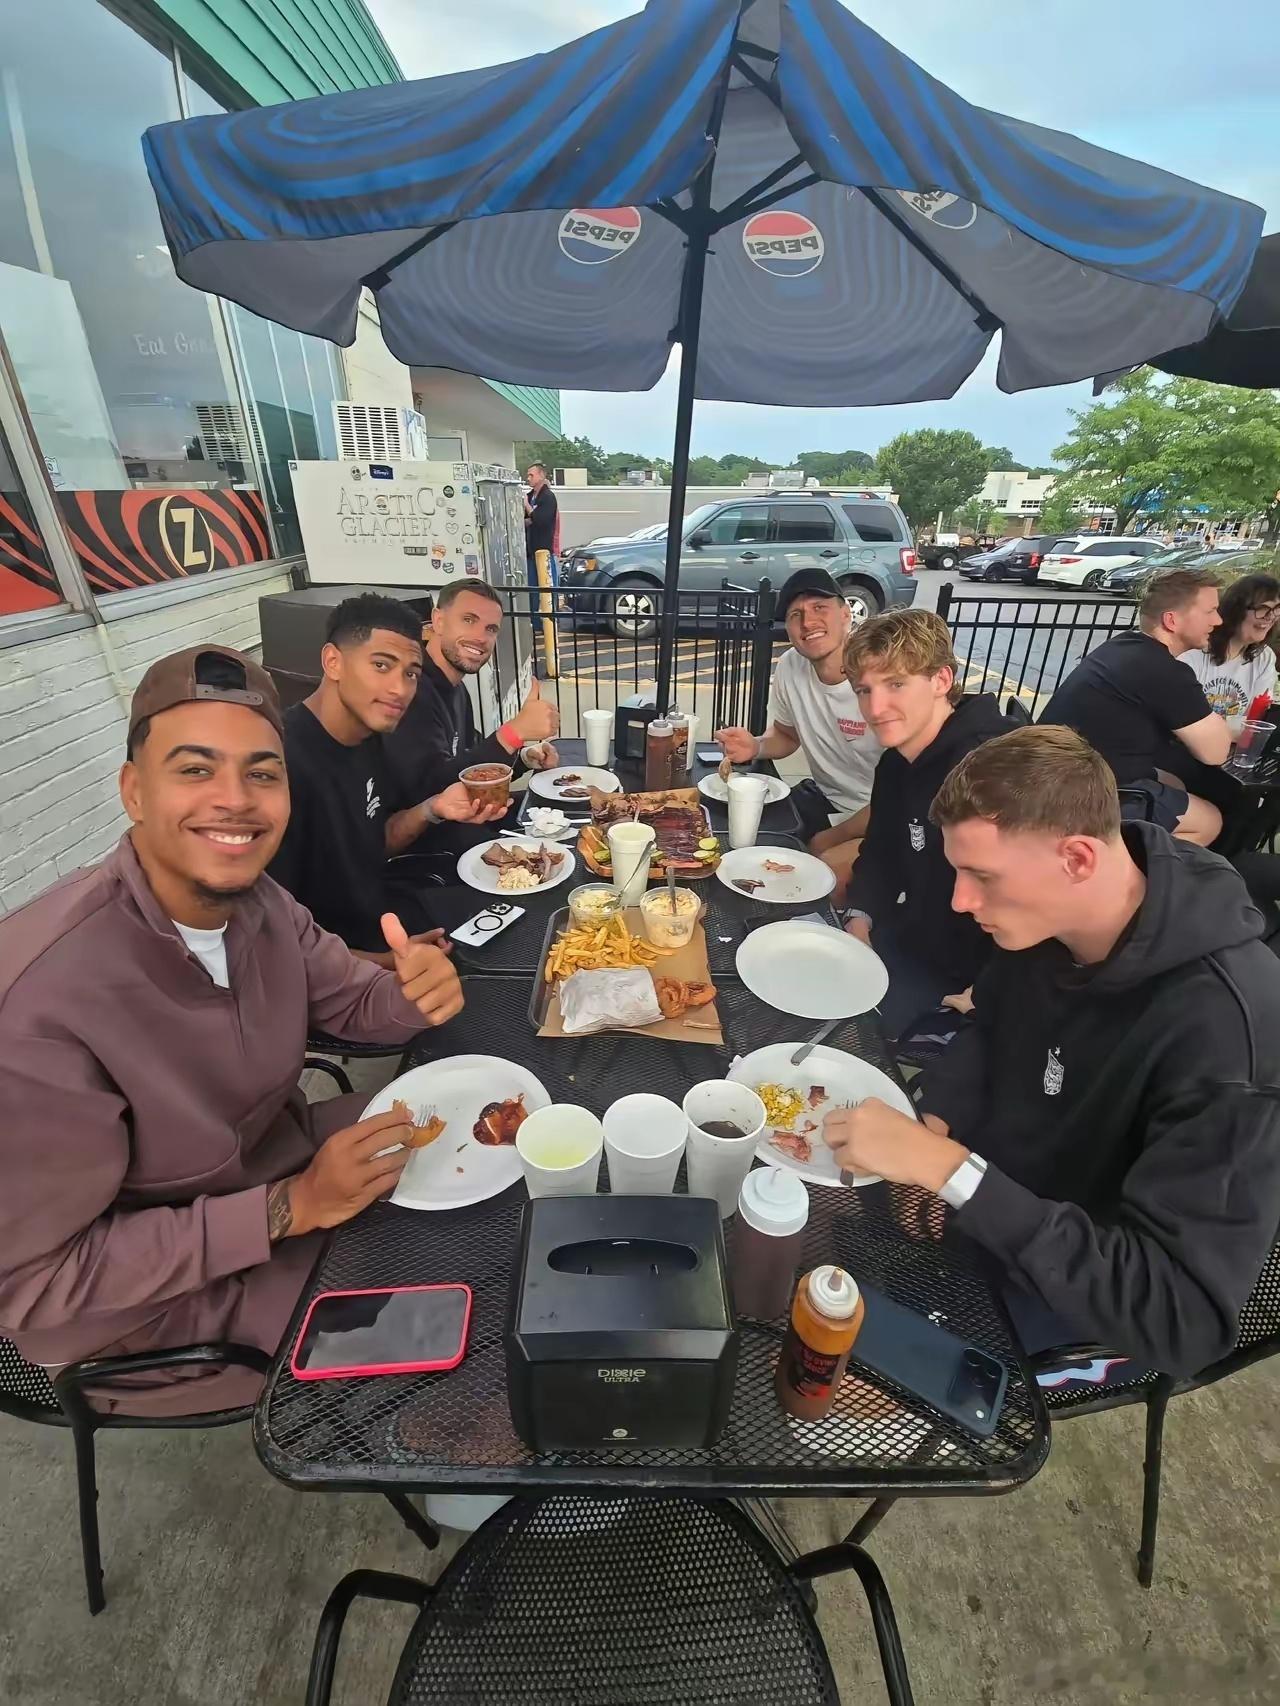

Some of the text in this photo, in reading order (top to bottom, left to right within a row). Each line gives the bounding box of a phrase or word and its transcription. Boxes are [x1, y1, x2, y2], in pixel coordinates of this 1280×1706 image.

[337, 487, 435, 516] ARCTIC
[170, 507, 207, 566] Z
[341, 517, 438, 537] GLACIER
